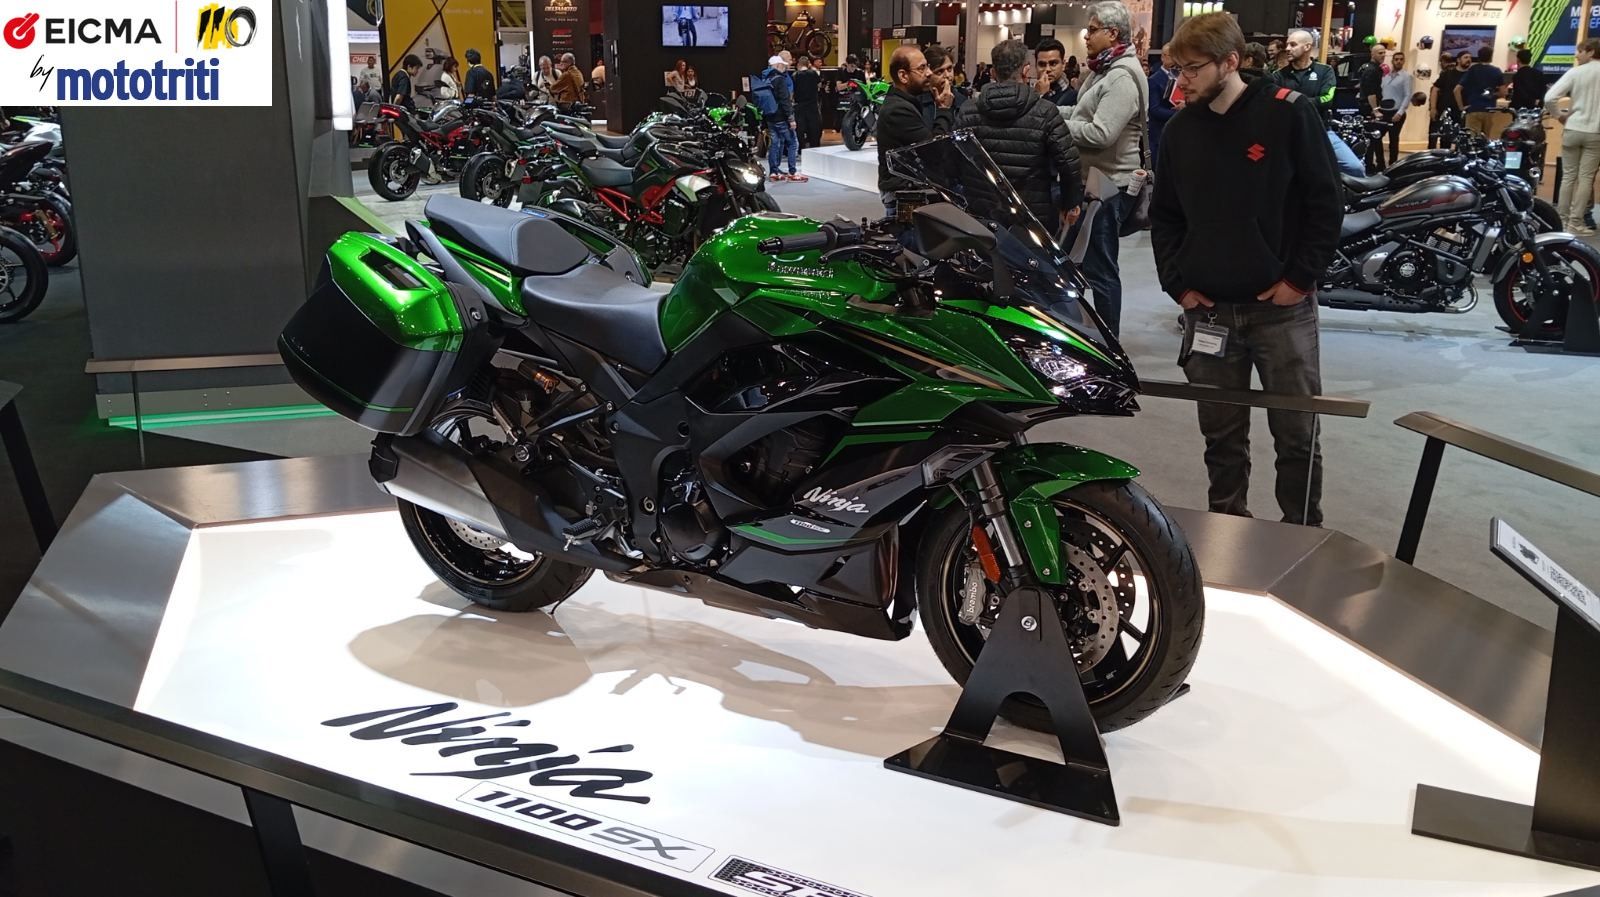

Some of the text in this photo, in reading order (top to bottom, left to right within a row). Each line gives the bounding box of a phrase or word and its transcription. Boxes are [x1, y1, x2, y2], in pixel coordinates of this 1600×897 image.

[803, 486, 869, 513] Ninja
[966, 582, 978, 613] brembo
[320, 701, 653, 805] Ninja
